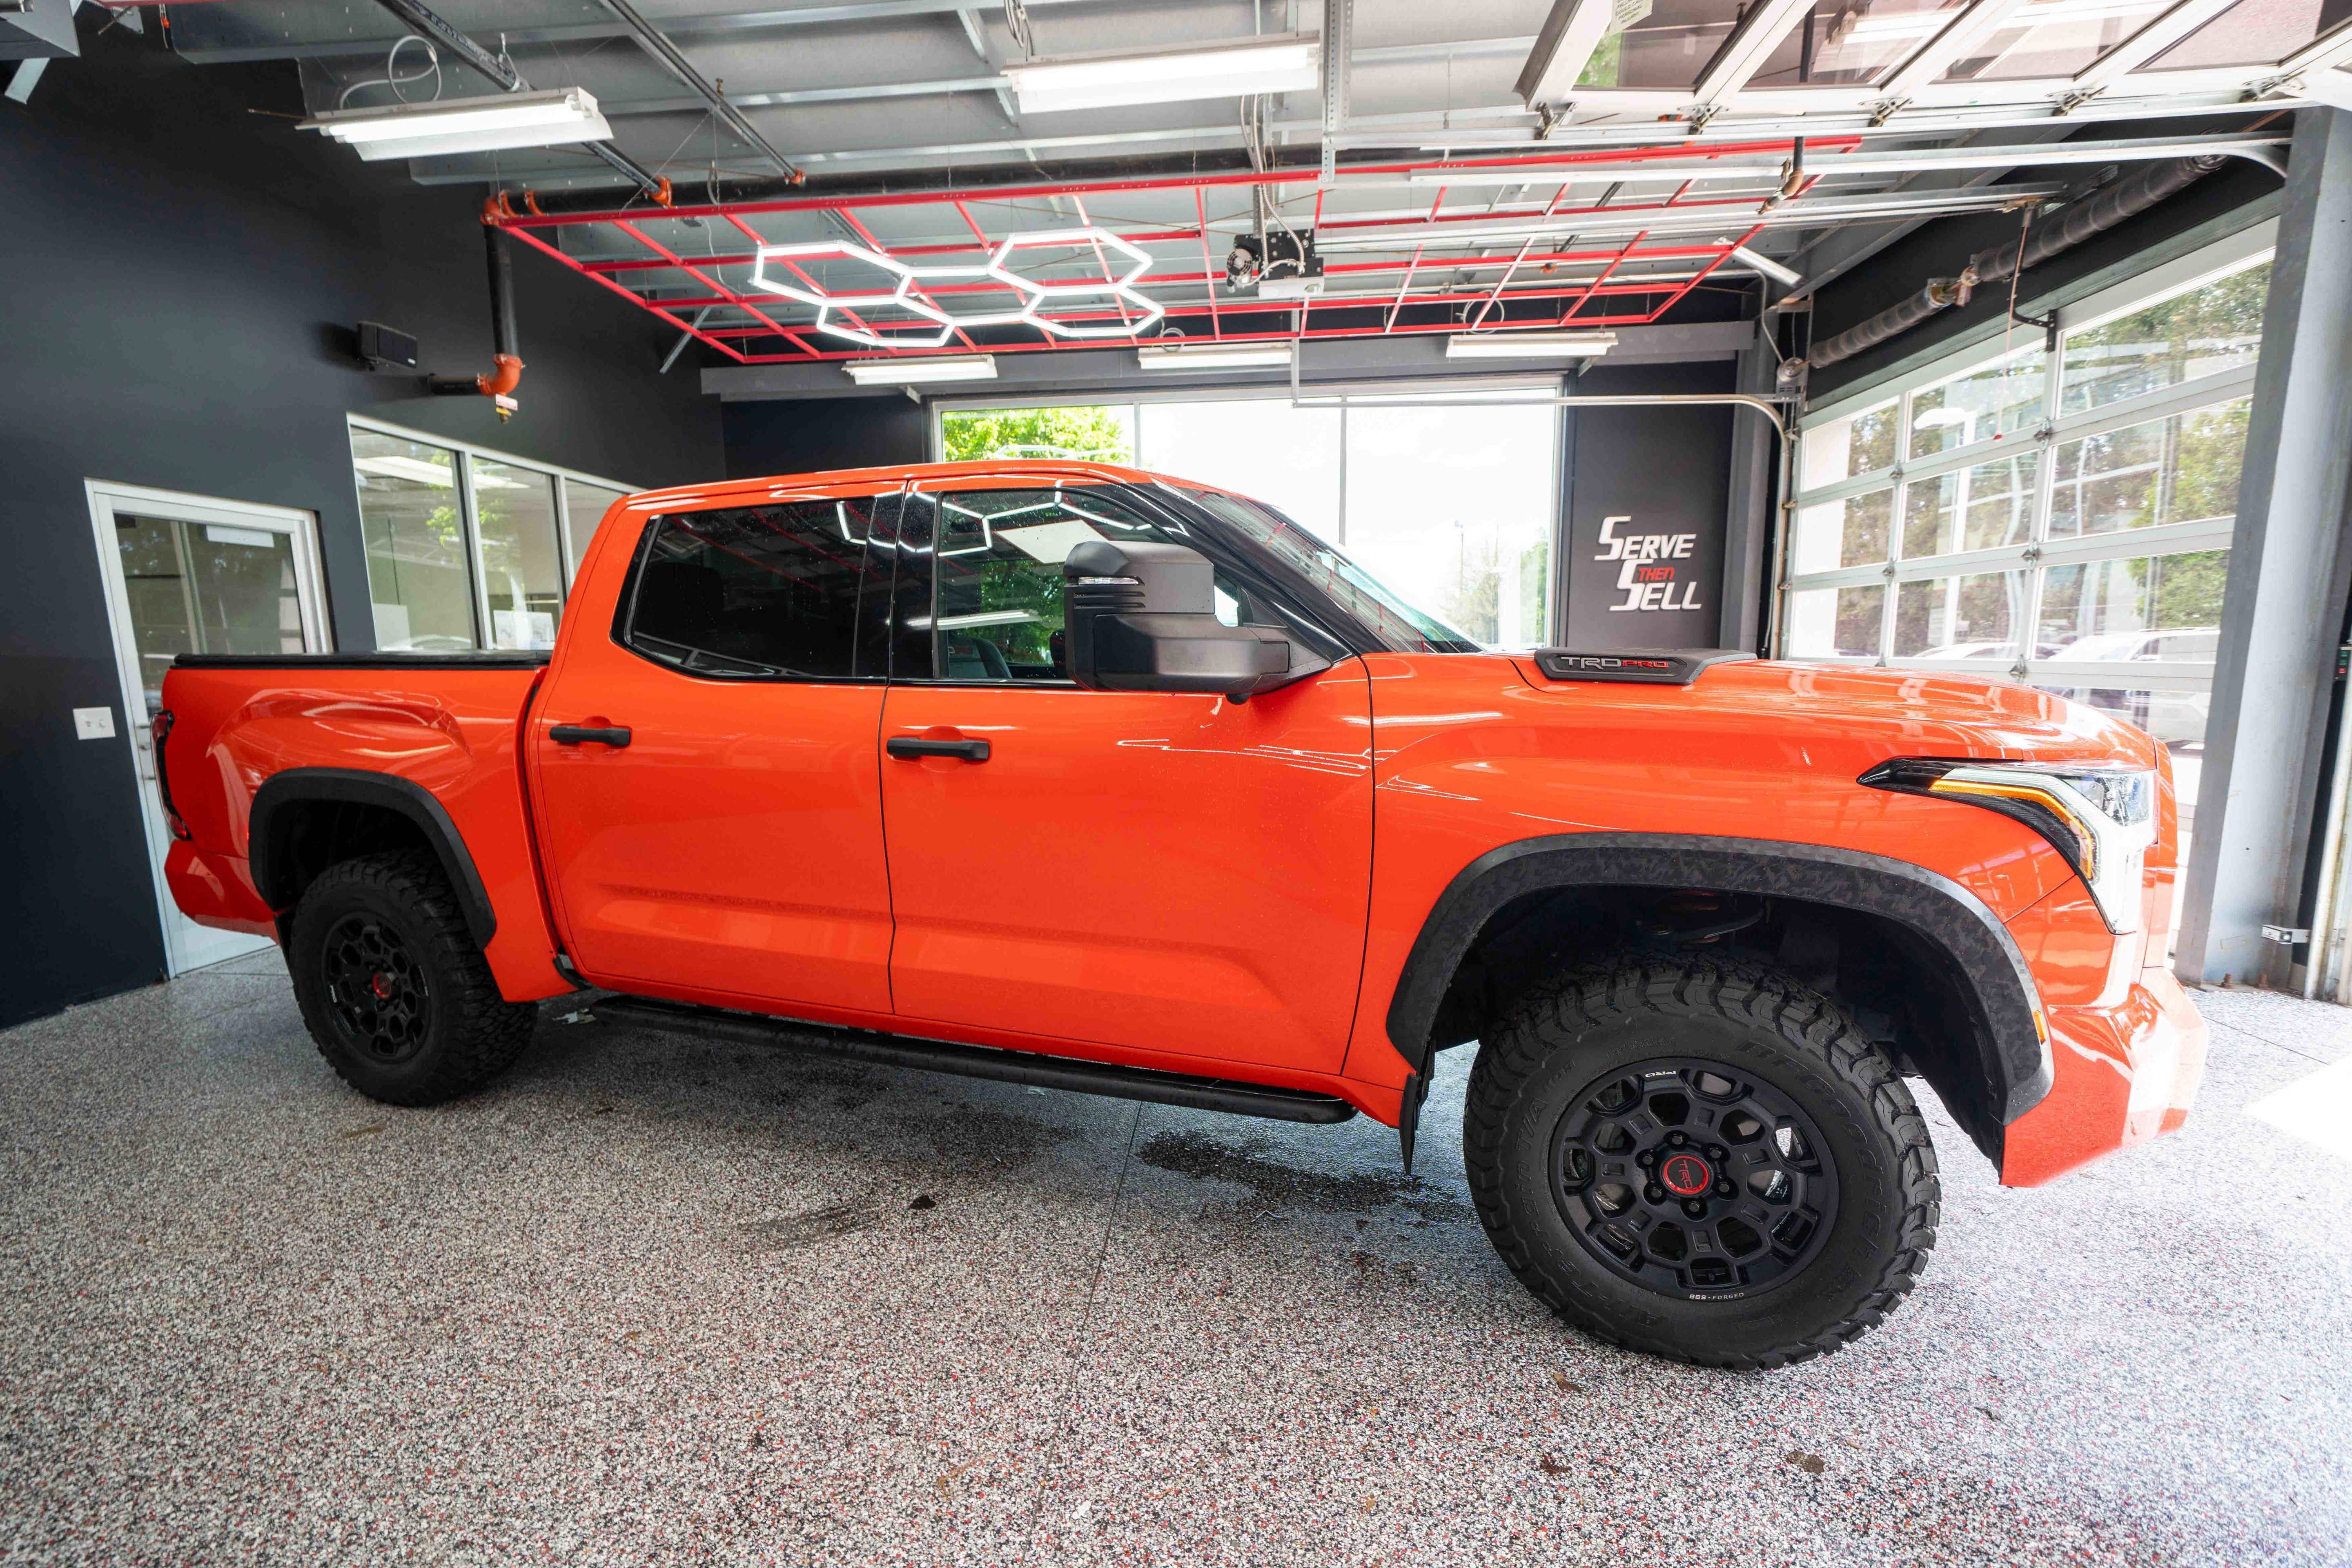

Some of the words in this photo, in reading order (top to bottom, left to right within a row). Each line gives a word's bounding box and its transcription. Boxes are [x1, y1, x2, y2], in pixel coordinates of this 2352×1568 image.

[1595, 516, 1696, 561] SERVE
[1610, 559, 1702, 610] SELL
[1638, 567, 1674, 581] THEN
[1561, 657, 1621, 670] TRD
[1623, 660, 1669, 668] PRO
[1679, 1159, 1693, 1189] TRD
